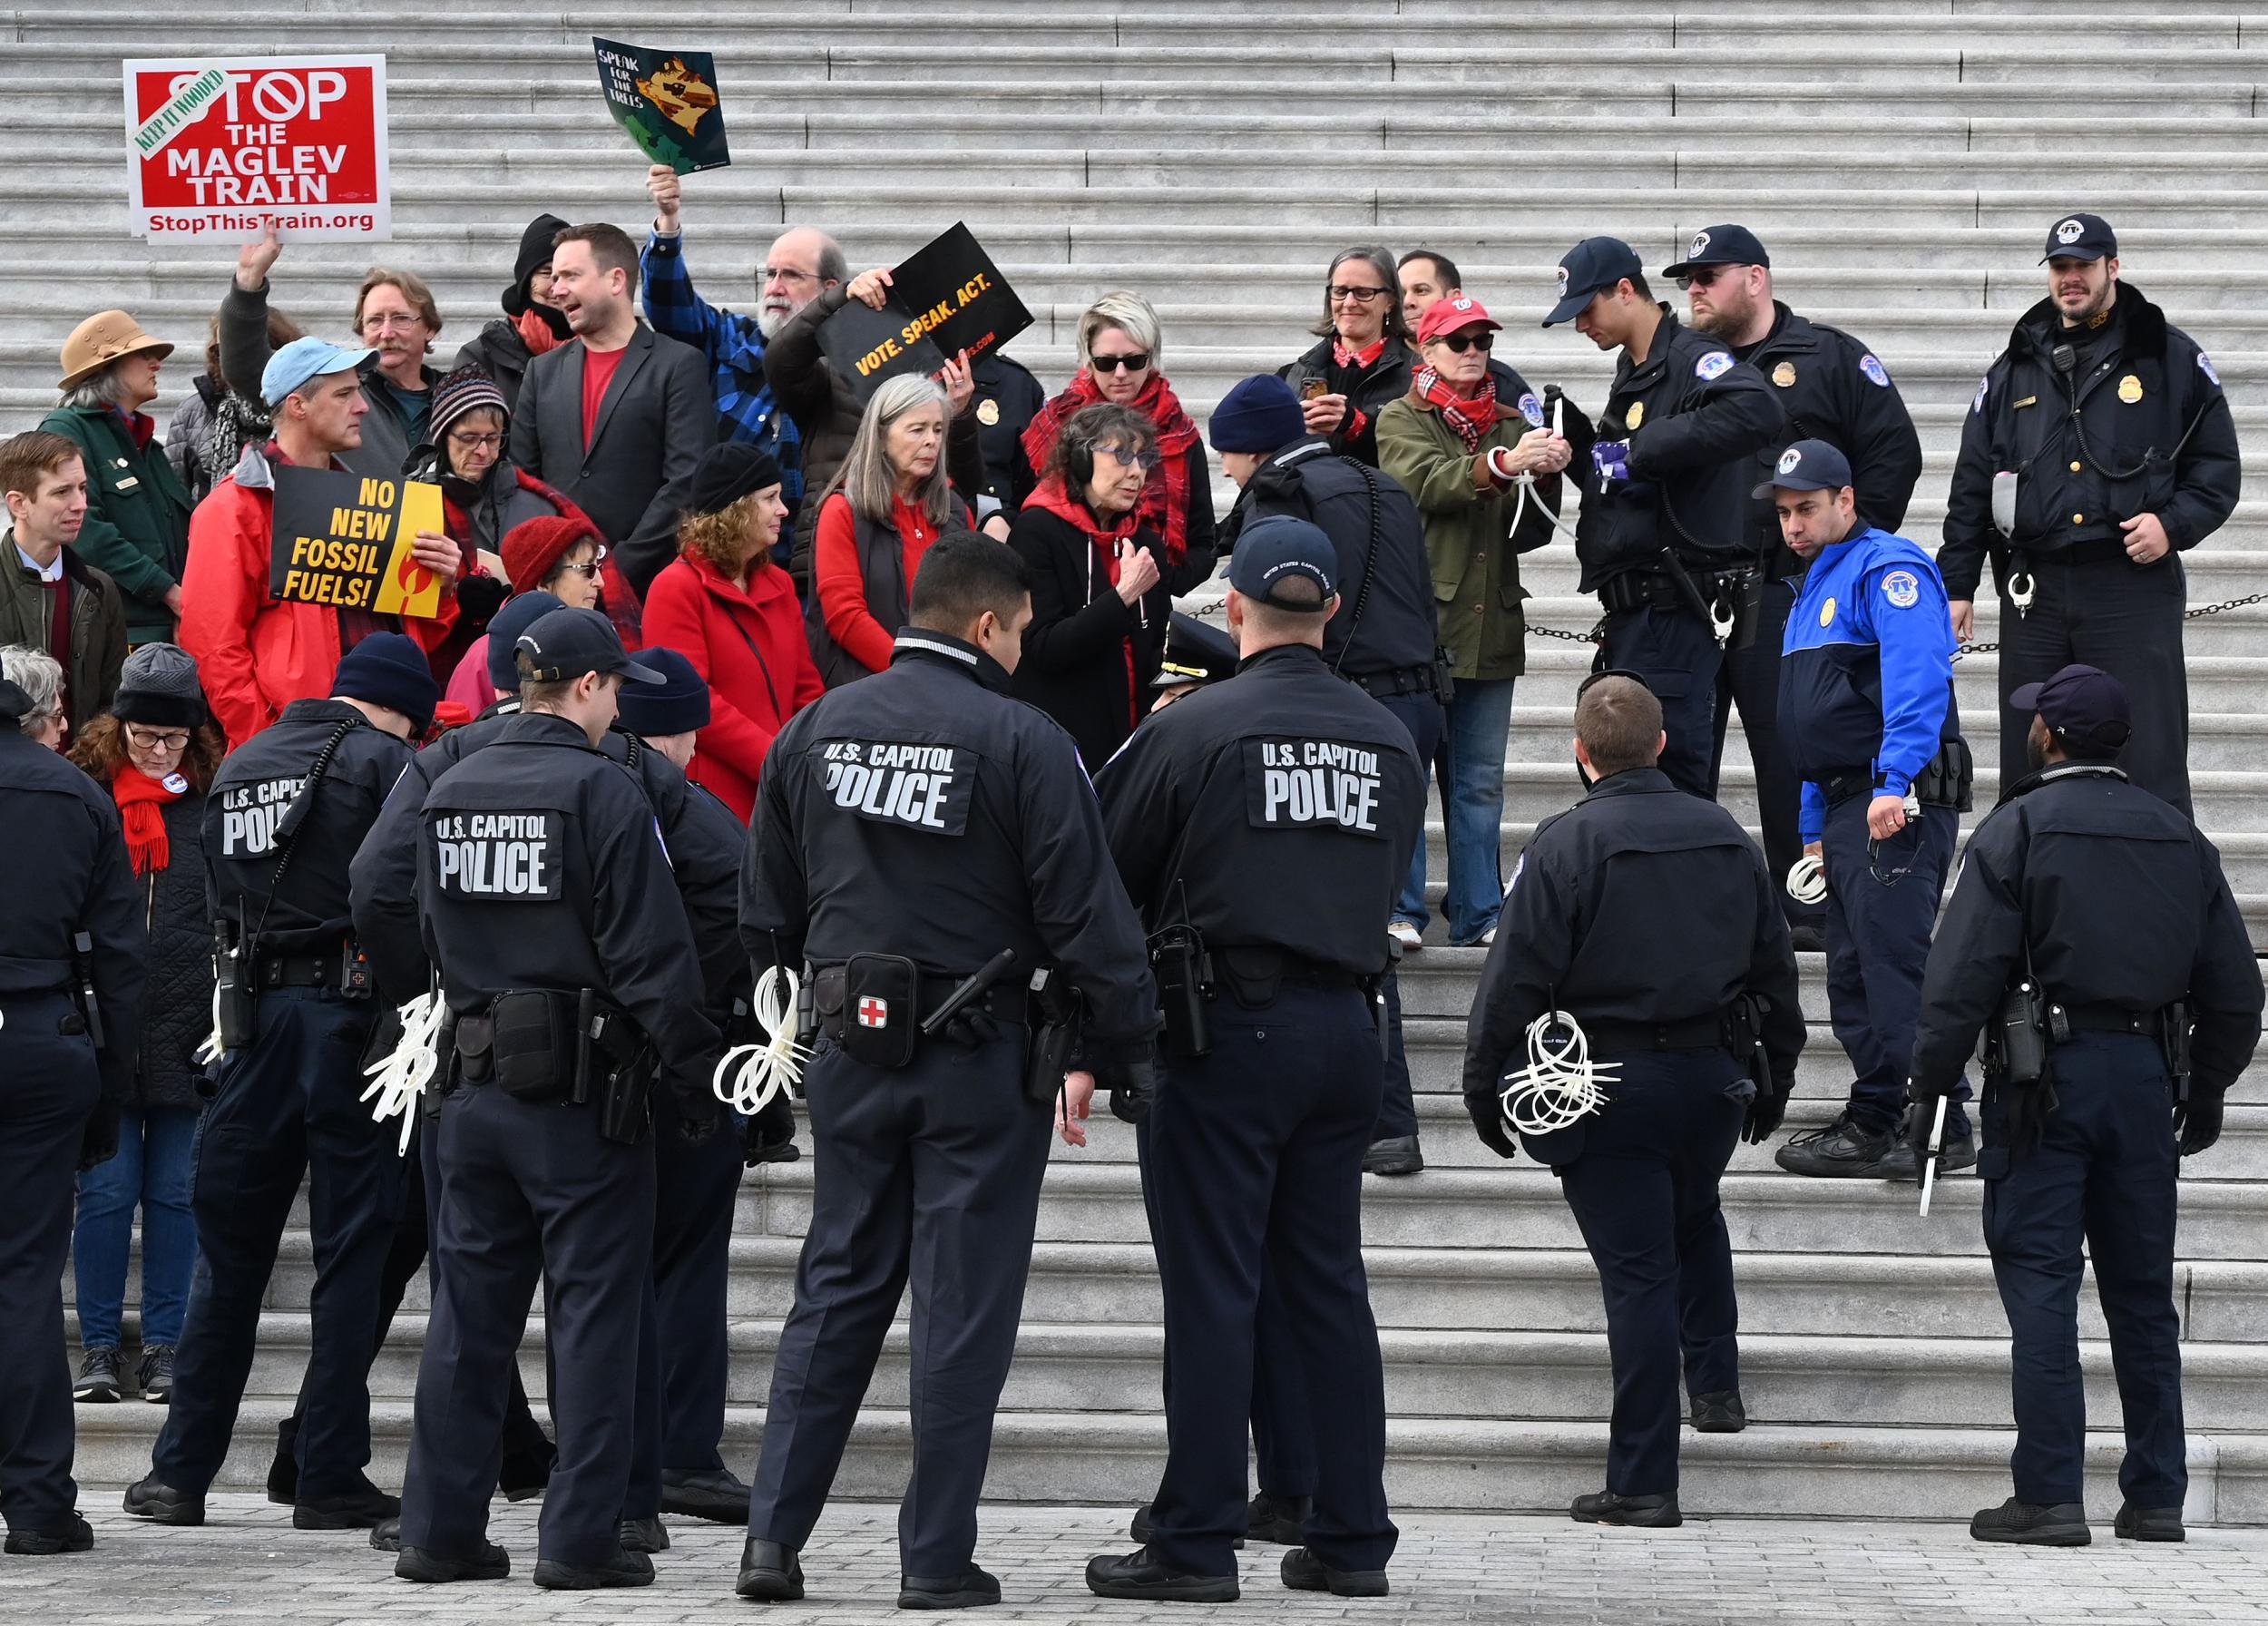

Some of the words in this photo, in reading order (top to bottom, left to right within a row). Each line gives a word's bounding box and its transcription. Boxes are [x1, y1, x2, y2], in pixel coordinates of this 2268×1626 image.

[598, 49, 639, 72] SPEAK
[610, 66, 631, 82] FOR
[608, 88, 644, 109] TREES
[611, 78, 631, 93] THE
[134, 118, 167, 152] KEEP
[161, 107, 181, 127] IT
[172, 69, 224, 116] WOODED
[224, 123, 287, 145] THE
[167, 144, 347, 177] MAGLEV
[186, 174, 327, 205] TRAIN
[149, 212, 374, 234] StopThisTrain.org
[855, 338, 904, 377] VOTE.
[901, 299, 958, 346] SPEAK.
[955, 272, 992, 308] ACT.
[358, 477, 396, 509] NO
[328, 507, 392, 542] NEW
[290, 536, 378, 574] FOSSIL
[282, 570, 373, 607] FUELS!
[824, 742, 863, 762] U.S.
[868, 744, 954, 772] CAPITOL
[1262, 743, 1300, 767] U.S.
[1304, 742, 1382, 777] CAPITOL
[223, 788, 254, 810] U.S.
[826, 762, 953, 828] POLICE
[1265, 769, 1381, 832] POLICE
[435, 816, 467, 839] U.S.
[470, 815, 547, 838] CAPITOL
[437, 840, 548, 894] POLICE
